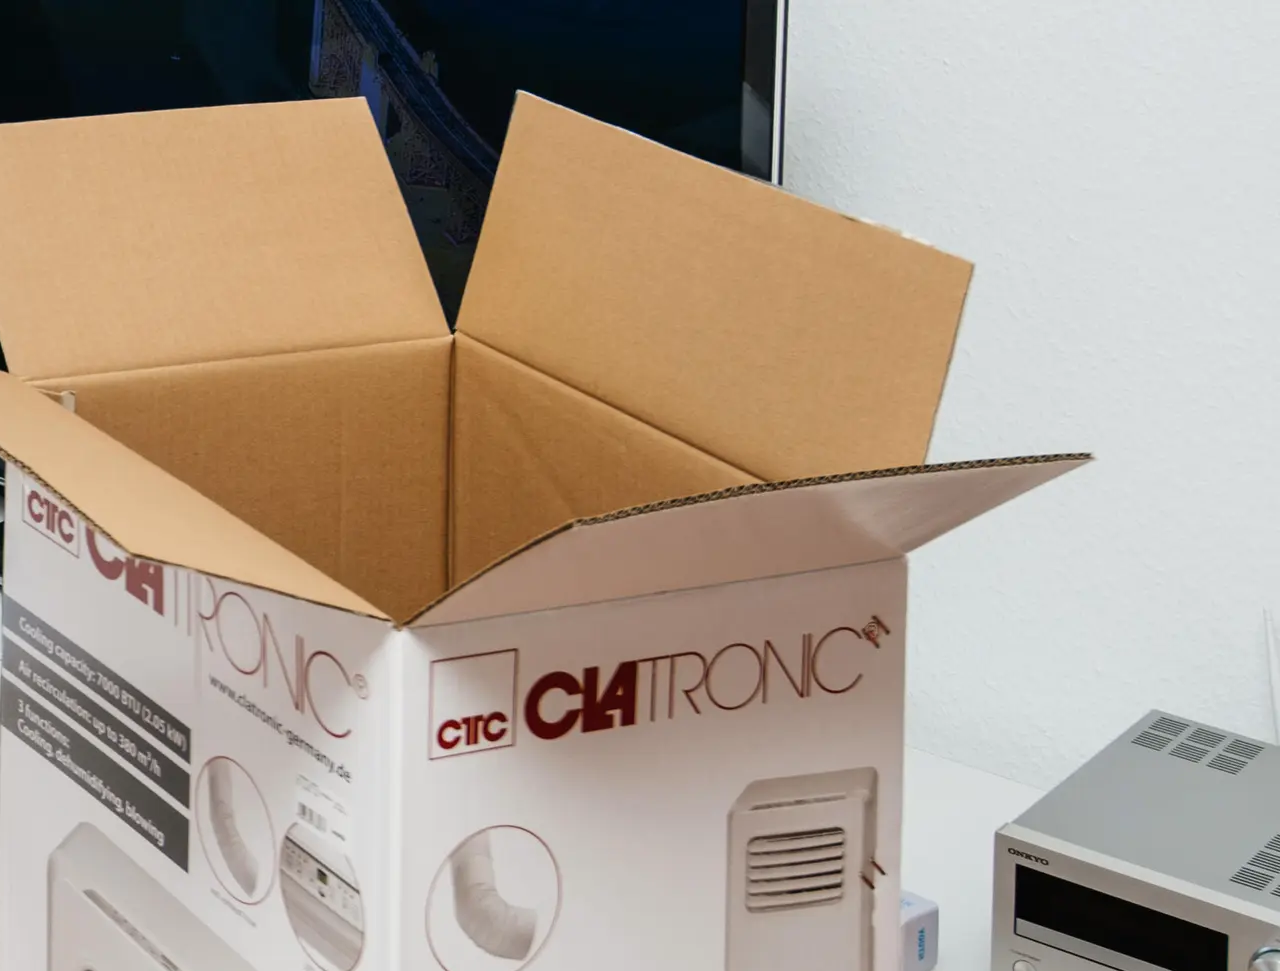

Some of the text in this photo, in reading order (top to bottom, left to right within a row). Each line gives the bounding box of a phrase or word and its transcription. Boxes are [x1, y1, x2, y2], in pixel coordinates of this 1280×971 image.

[27, 490, 74, 543] CTC
[17, 698, 71, 748] 3 functions:
[19, 615, 188, 753] Cooling capacity: 7000 BTU (2.05 kW)
[19, 658, 32, 681] Air
[33, 670, 91, 725] recirculation:
[93, 714, 106, 739] up
[107, 723, 118, 745] to
[119, 733, 137, 759] 380
[208, 672, 353, 783] www.clatronic-germany.de
[436, 626, 863, 749] CTC CLATRONIC
[17, 718, 166, 847] Cooling, dehumidifying, blowing
[1008, 847, 1049, 866] ONKYO
